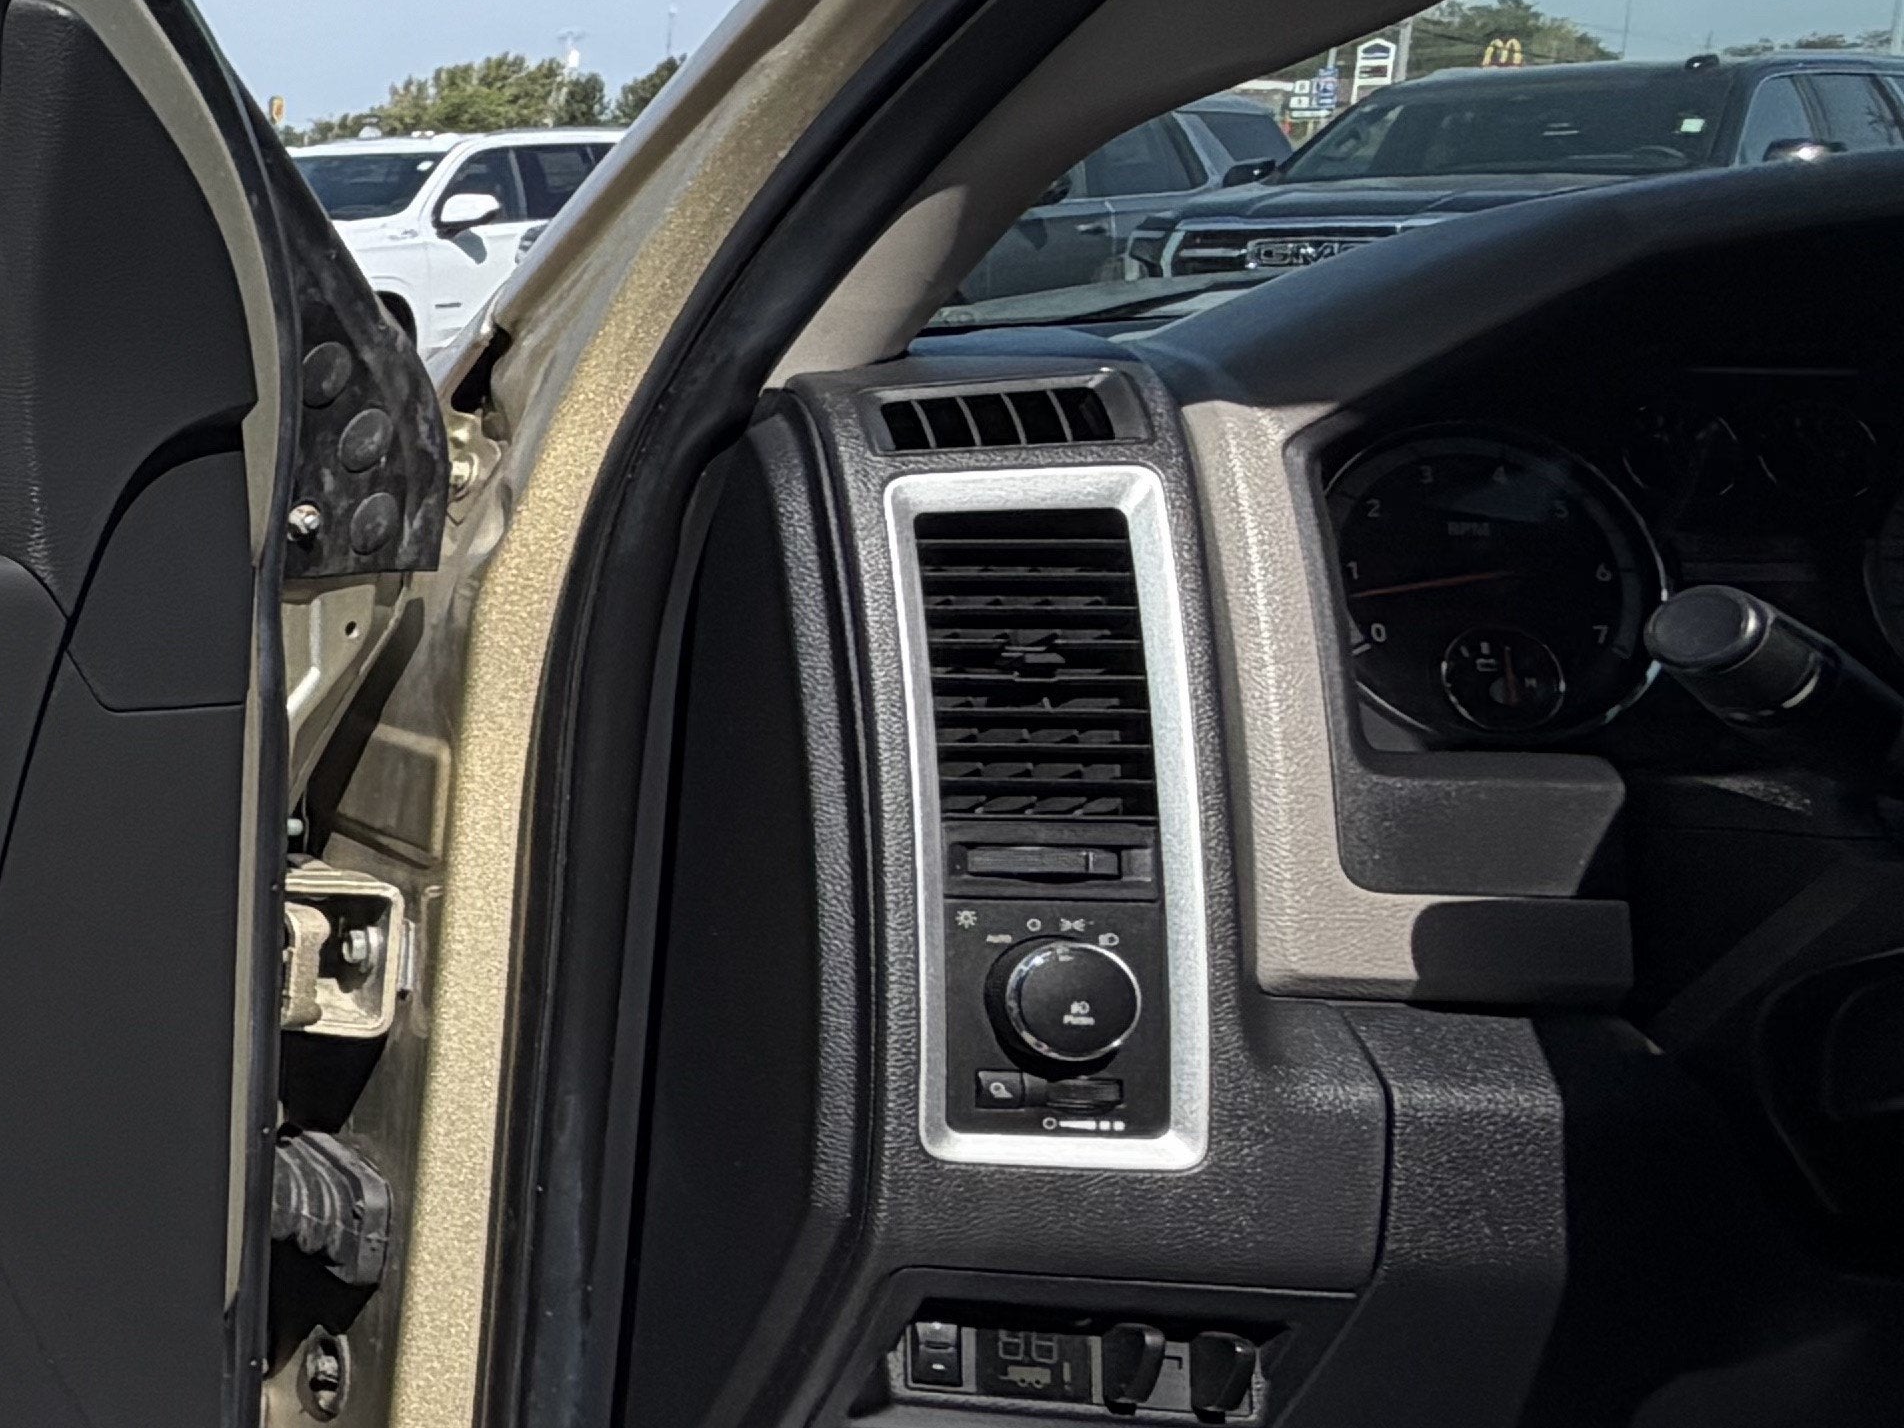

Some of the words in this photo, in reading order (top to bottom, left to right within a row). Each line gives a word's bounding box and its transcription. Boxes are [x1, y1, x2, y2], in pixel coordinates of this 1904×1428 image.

[1367, 499, 1381, 518] 2
[1346, 561, 1359, 580] 1
[1596, 563, 1613, 582] 6
[1370, 622, 1387, 643] 0
[1592, 624, 1610, 644] 7
